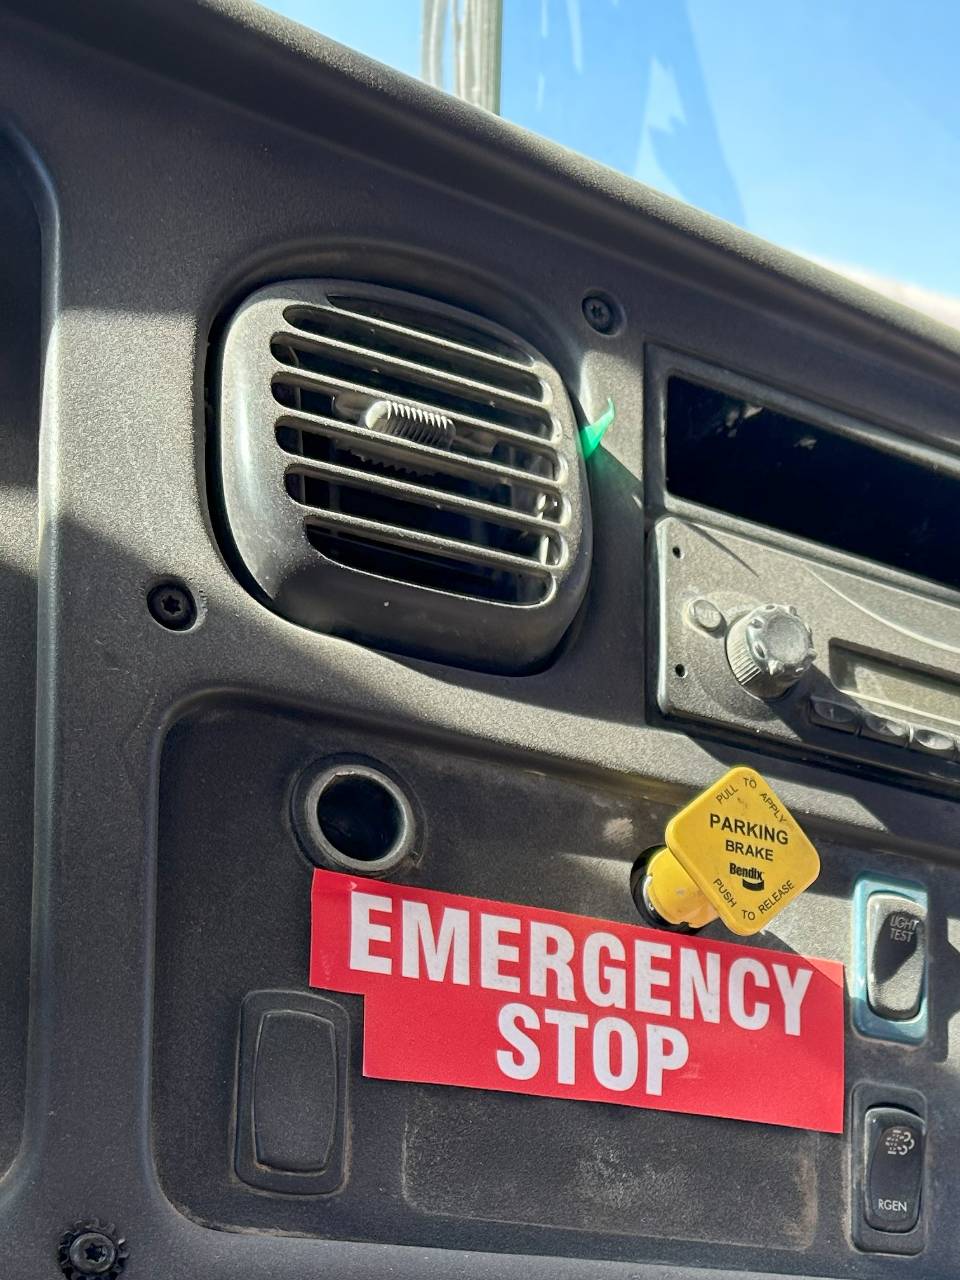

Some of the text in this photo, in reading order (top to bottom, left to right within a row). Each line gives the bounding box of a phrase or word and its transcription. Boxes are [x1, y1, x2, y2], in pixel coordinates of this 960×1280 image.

[715, 777, 788, 824] PULL TO APPLY
[709, 813, 789, 846] PARKING
[725, 839, 774, 862] BRAKE
[729, 862, 764, 881] Bendix
[712, 878, 795, 921] PUSH TO RELEASE
[889, 927, 914, 943] TEST
[348, 890, 813, 1037] EMERGENCY
[495, 1002, 689, 1097] STOP
[878, 1198, 907, 1212] RGEN
